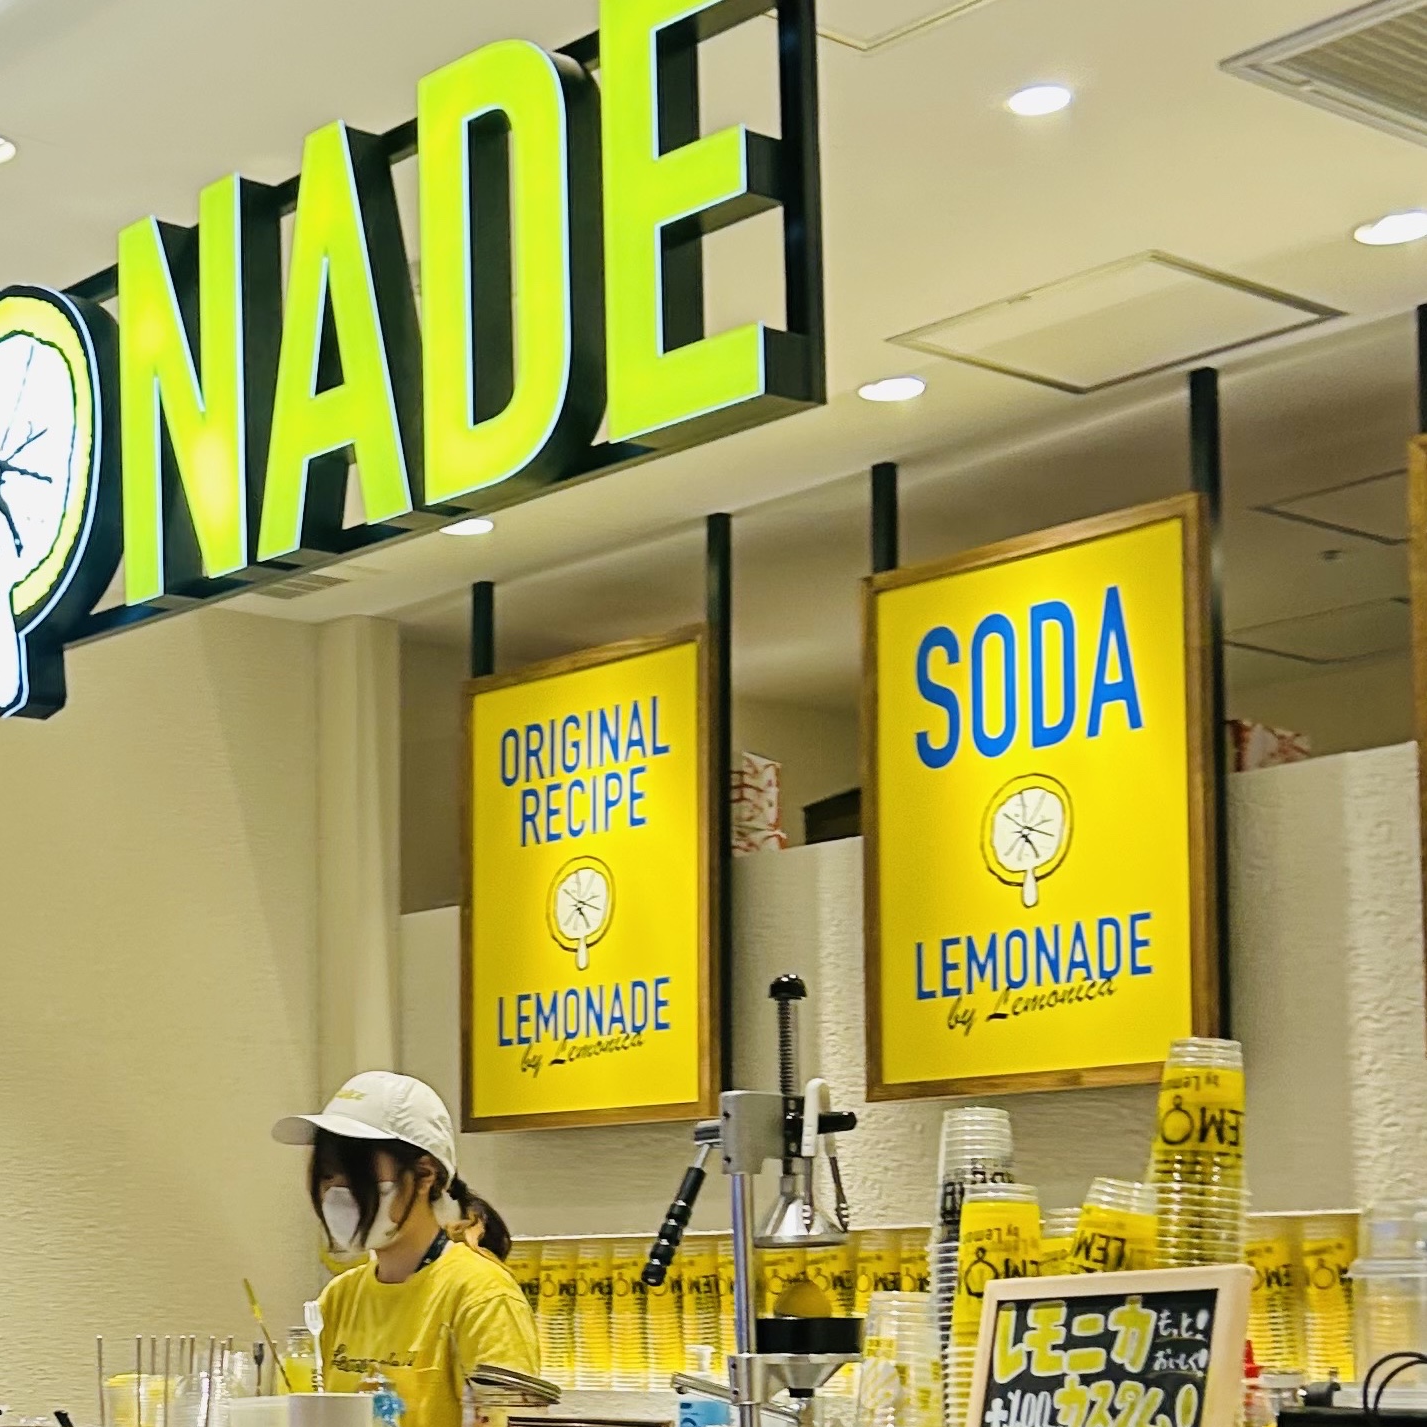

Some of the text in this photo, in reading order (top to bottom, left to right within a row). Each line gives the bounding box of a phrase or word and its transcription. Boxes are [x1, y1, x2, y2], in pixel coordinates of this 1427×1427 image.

[915, 585, 1145, 770] SODA
[499, 695, 672, 787] ORIGINAL
[519, 764, 649, 848] RECIPE
[915, 910, 1154, 1000] LEMONADE
[496, 976, 672, 1047] LEMONADE
[946, 976, 1118, 1036] by Lemonica
[519, 1041, 543, 1078] by
[993, 1295, 1157, 1384] レモニカ
